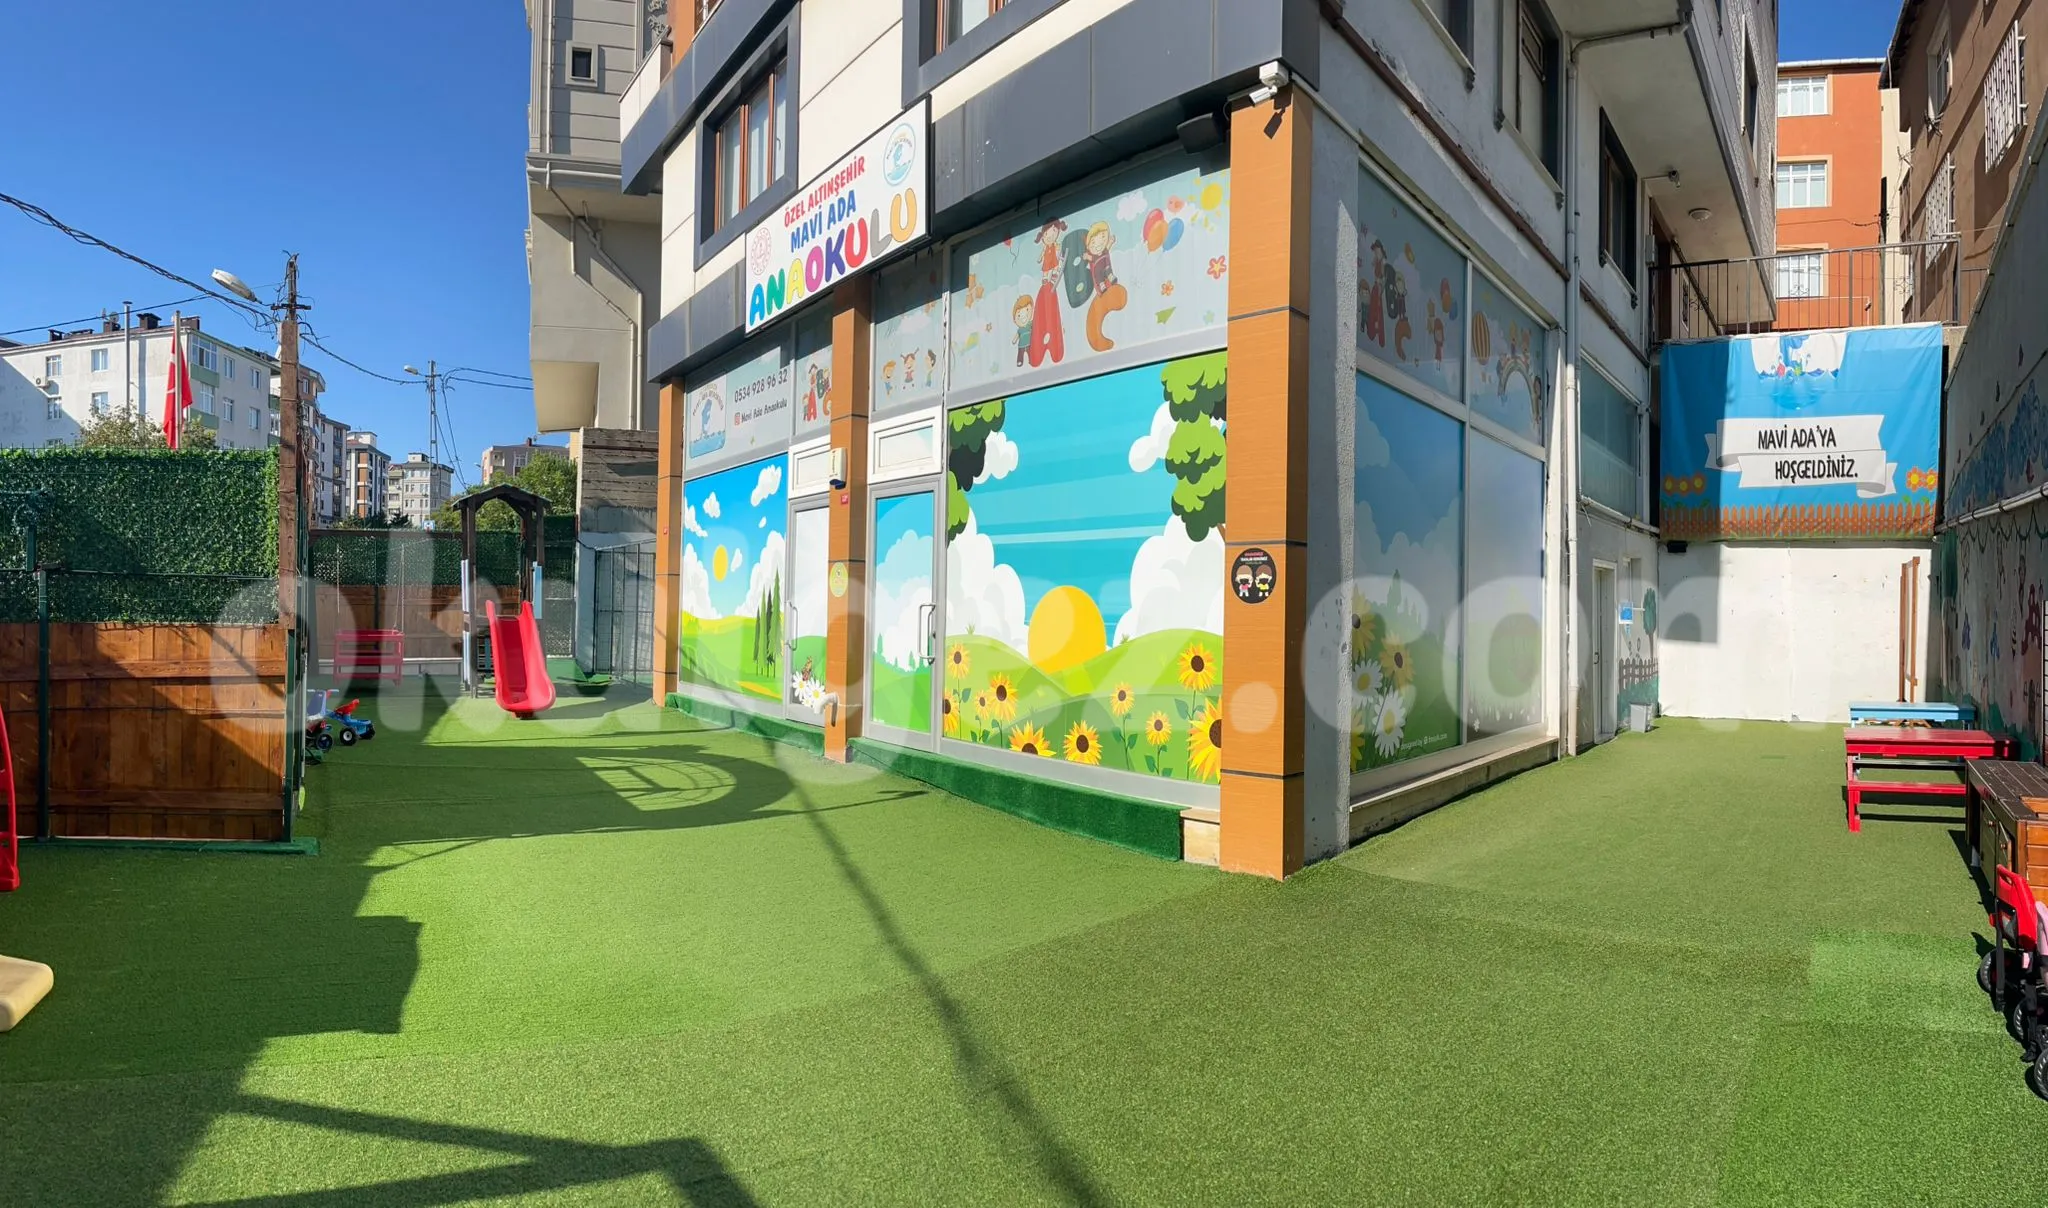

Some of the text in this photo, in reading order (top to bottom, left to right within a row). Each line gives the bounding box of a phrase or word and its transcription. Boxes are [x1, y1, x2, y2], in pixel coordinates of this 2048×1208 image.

[784, 155, 866, 229] ÖZEL ALTINŞEHİR
[790, 189, 857, 253] MAVİ ADA
[749, 187, 918, 326] ANAOKULU
[734, 385, 751, 403] 0534
[752, 378, 765, 395] 928
[767, 374, 776, 389] 96
[778, 368, 788, 385] 32
[741, 410, 753, 423] Mavi
[764, 398, 788, 415] Anaokulu
[1757, 424, 1837, 450] MAVİ ADA'YA
[1774, 454, 1859, 483] HOŞGELDİNİZ.
